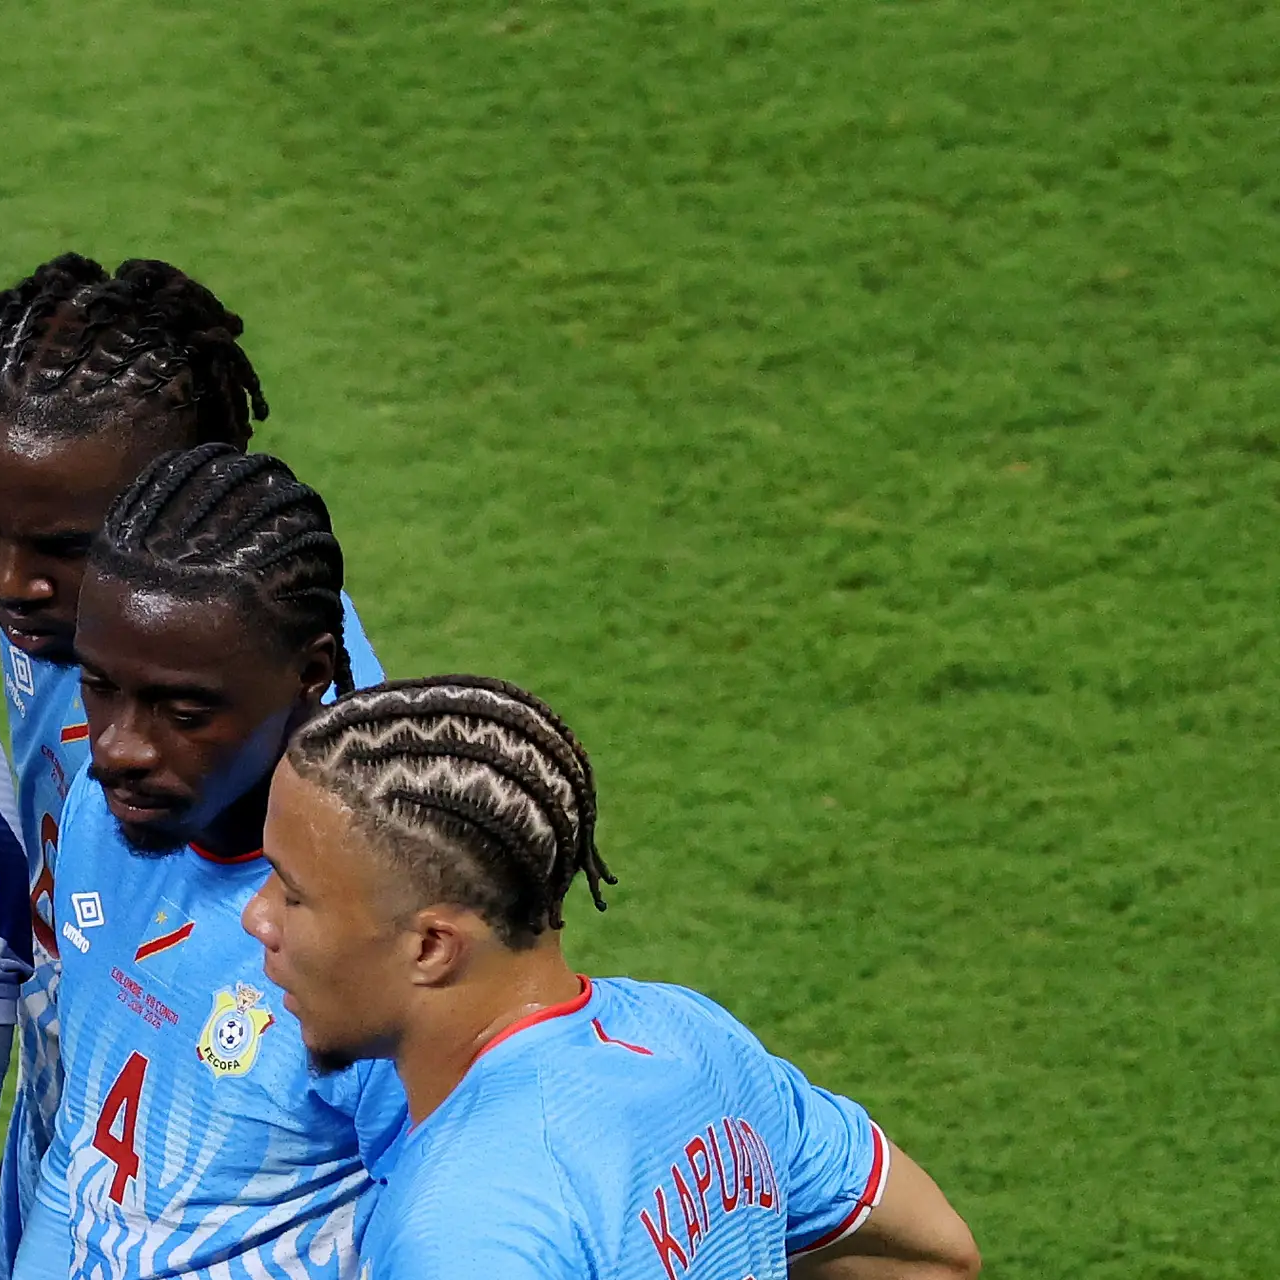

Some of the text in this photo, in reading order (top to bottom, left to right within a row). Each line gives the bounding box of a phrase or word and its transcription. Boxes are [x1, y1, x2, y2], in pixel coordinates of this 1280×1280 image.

[62, 921, 90, 954] umbro
[204, 1046, 241, 1070] FECOFA
[92, 1050, 149, 1205] 4
